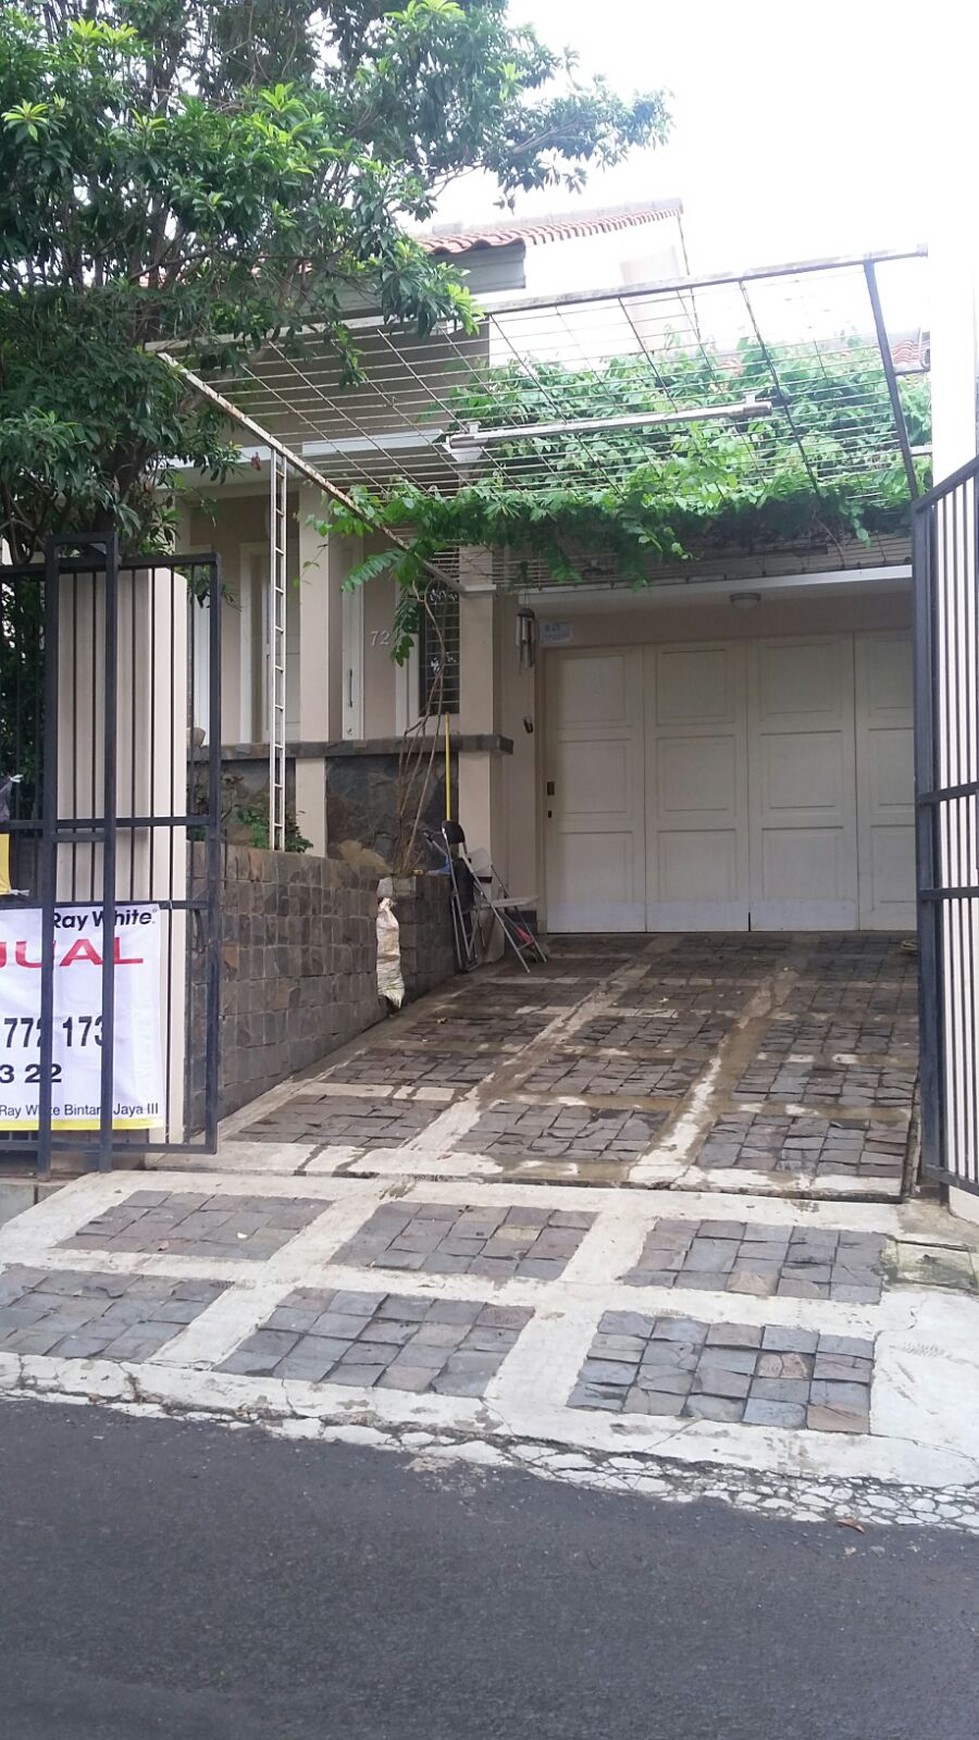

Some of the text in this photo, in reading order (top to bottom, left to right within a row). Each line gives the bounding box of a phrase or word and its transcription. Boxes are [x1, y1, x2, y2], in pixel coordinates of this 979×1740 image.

[371, 630, 390, 646] 72
[54, 912, 88, 931] Ray
[24, 1063, 62, 1083] 22
[0, 1105, 22, 1118] Ray
[64, 1104, 104, 1116] Bintar
[113, 1103, 143, 1117] Jaya
